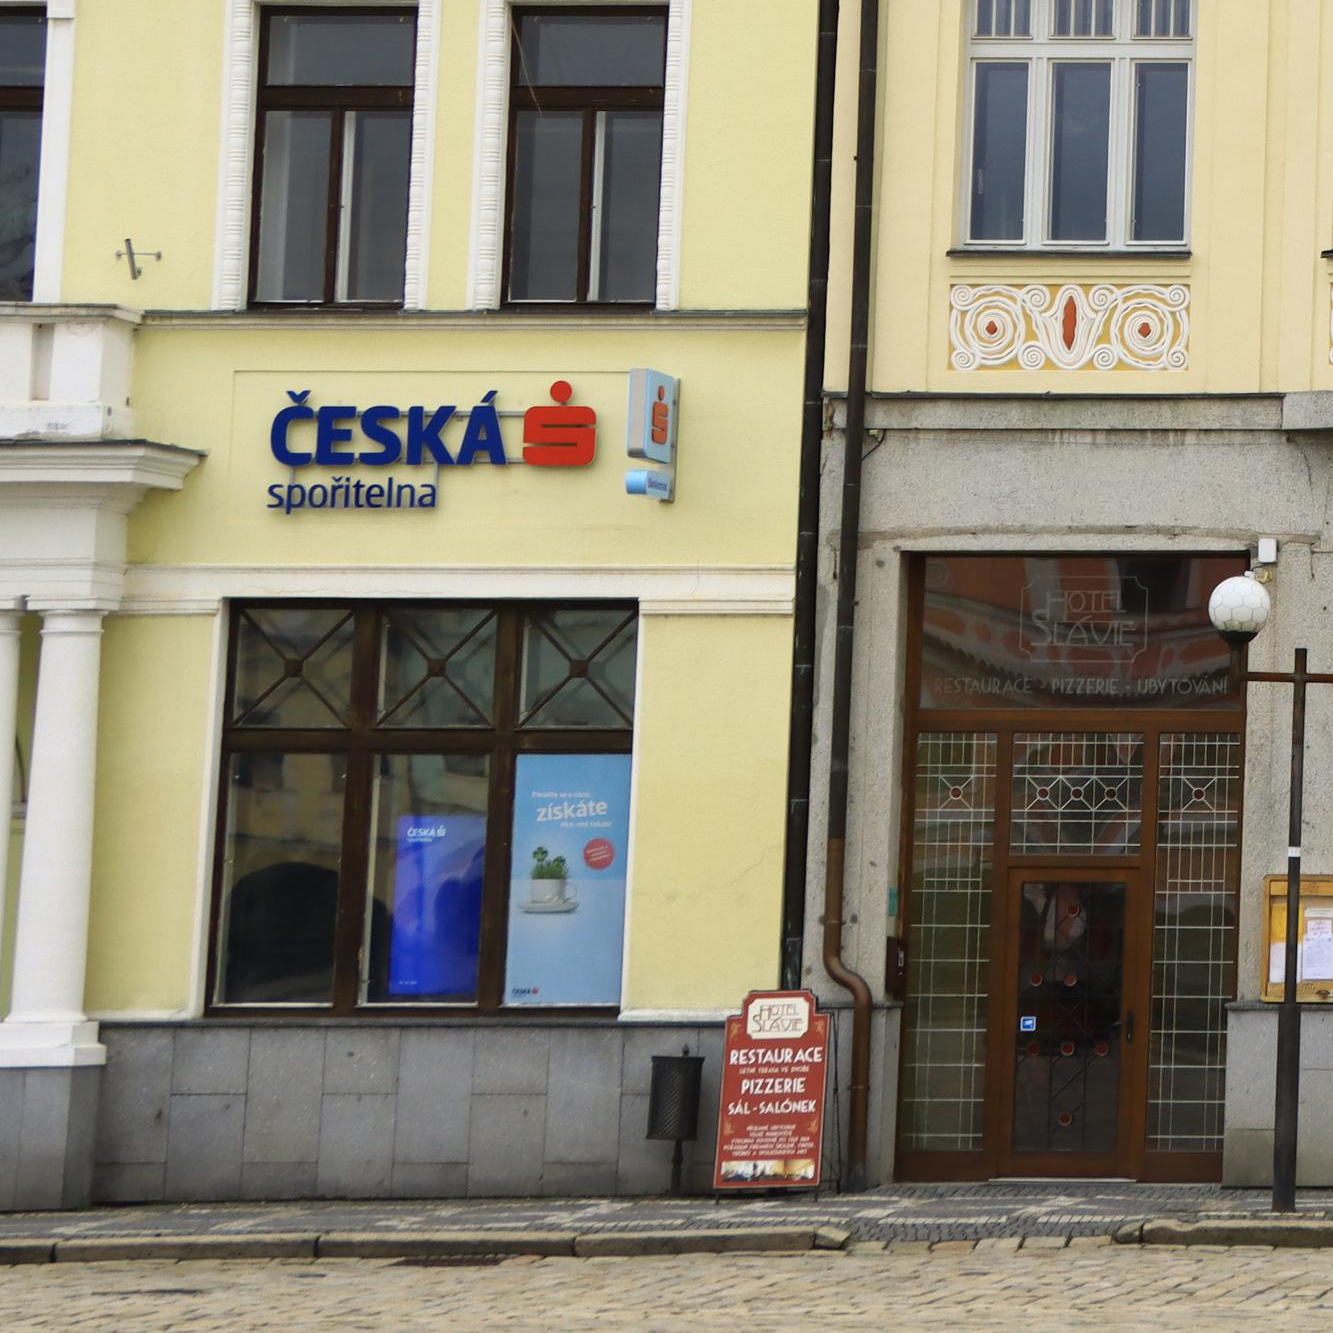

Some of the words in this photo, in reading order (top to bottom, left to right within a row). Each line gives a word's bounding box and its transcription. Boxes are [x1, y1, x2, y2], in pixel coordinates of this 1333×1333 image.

[270, 390, 507, 466] ČESKÁ
[266, 476, 437, 515] spořitelna
[1046, 590, 1126, 621] HOTEL
[934, 677, 1033, 695] RESTAURACE
[1051, 677, 1119, 695] PIZZERIE
[1137, 674, 1229, 695] UBYTOVÁNÍ
[536, 799, 609, 823] získáte
[760, 1003, 799, 1020] HOTEL
[729, 1047, 823, 1065] RESTAURACE
[741, 1077, 806, 1095] PIZZERIE
[728, 1099, 751, 1115] SÁL
[759, 1098, 817, 1115] SALÓNEK
